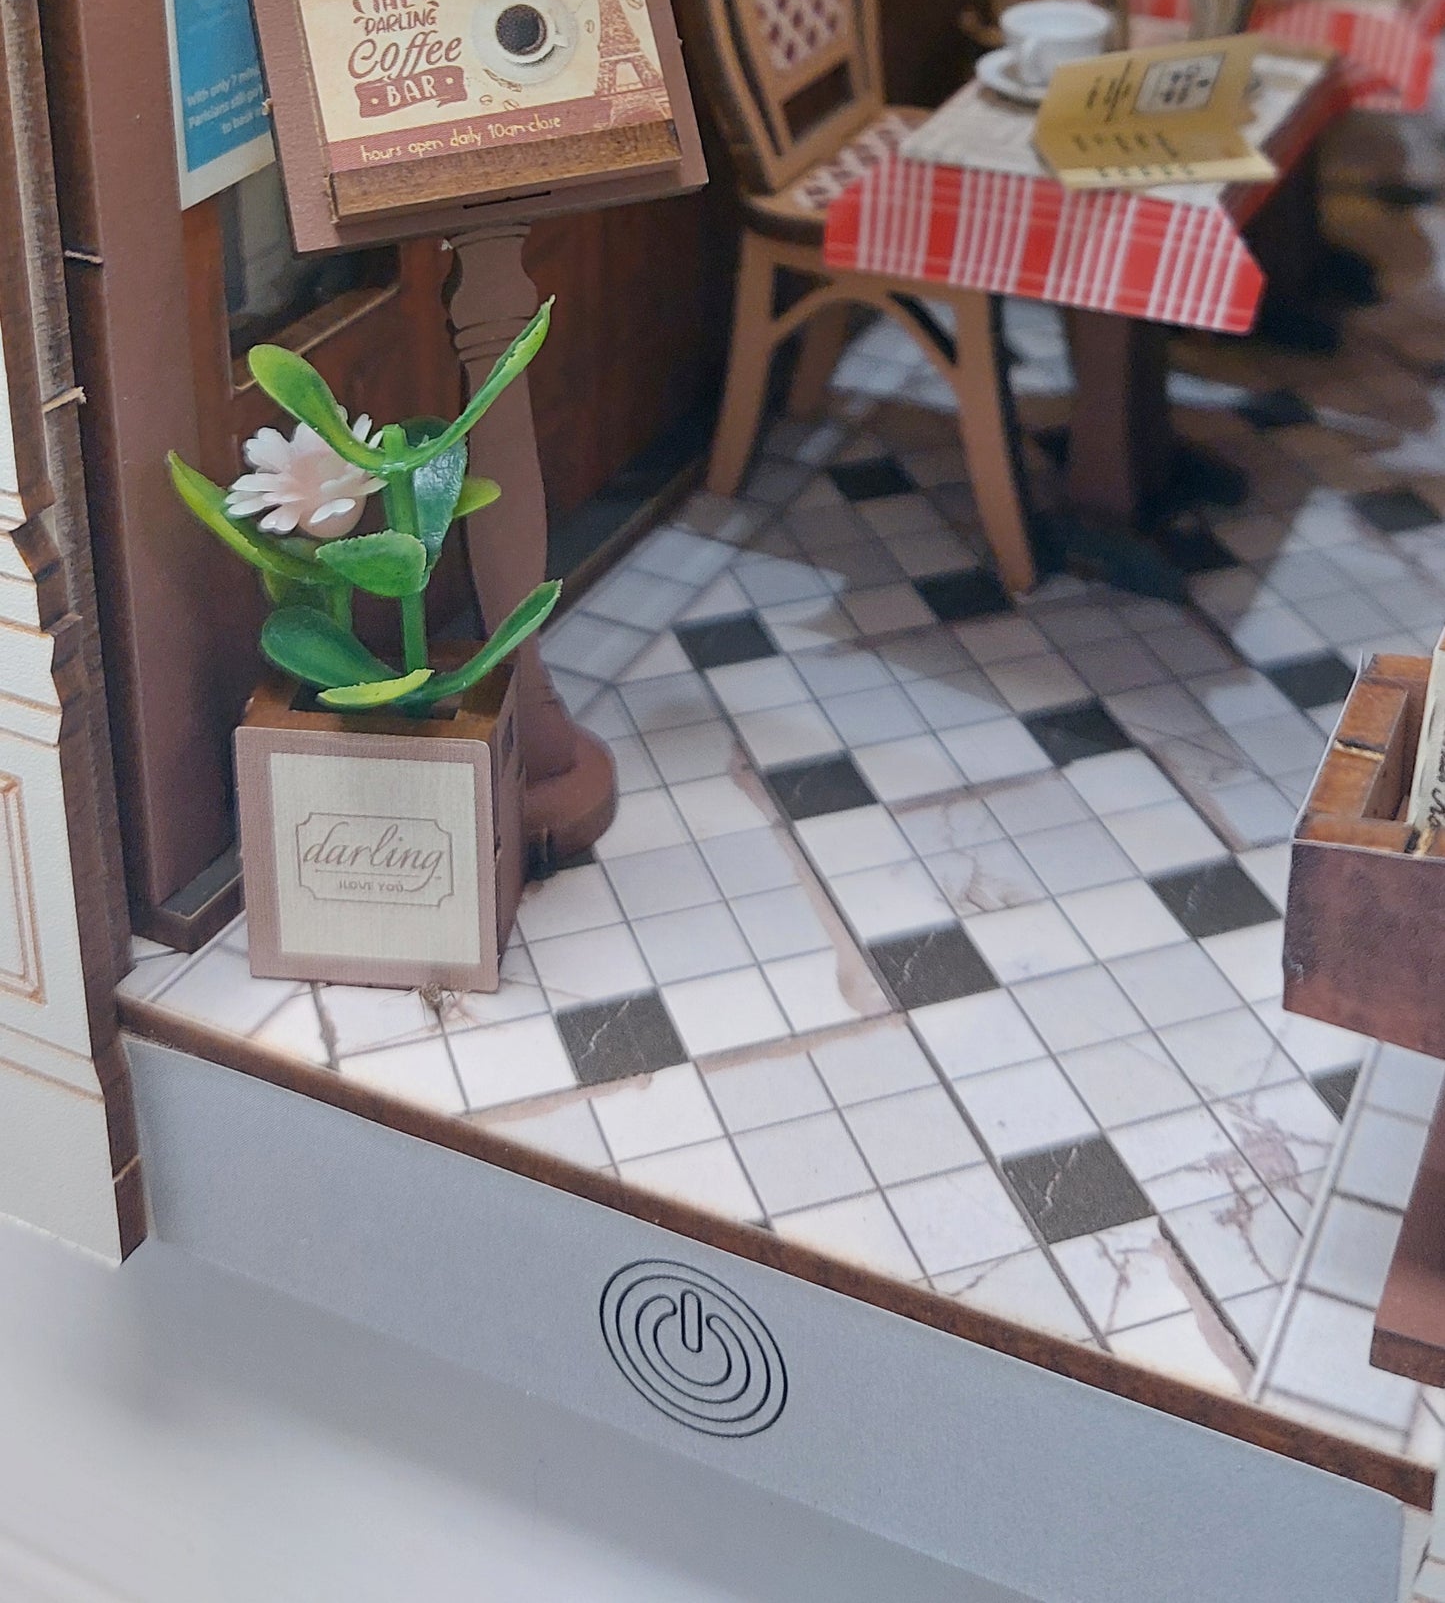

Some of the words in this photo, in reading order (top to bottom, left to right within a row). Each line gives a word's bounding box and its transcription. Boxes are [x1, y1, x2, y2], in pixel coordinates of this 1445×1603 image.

[364, 8, 438, 36] DARLING
[348, 30, 462, 79] Coffee
[386, 75, 438, 107] BAR
[361, 145, 401, 163] hours
[408, 139, 444, 157] open
[450, 125, 482, 147] daily
[302, 821, 445, 893] darling
